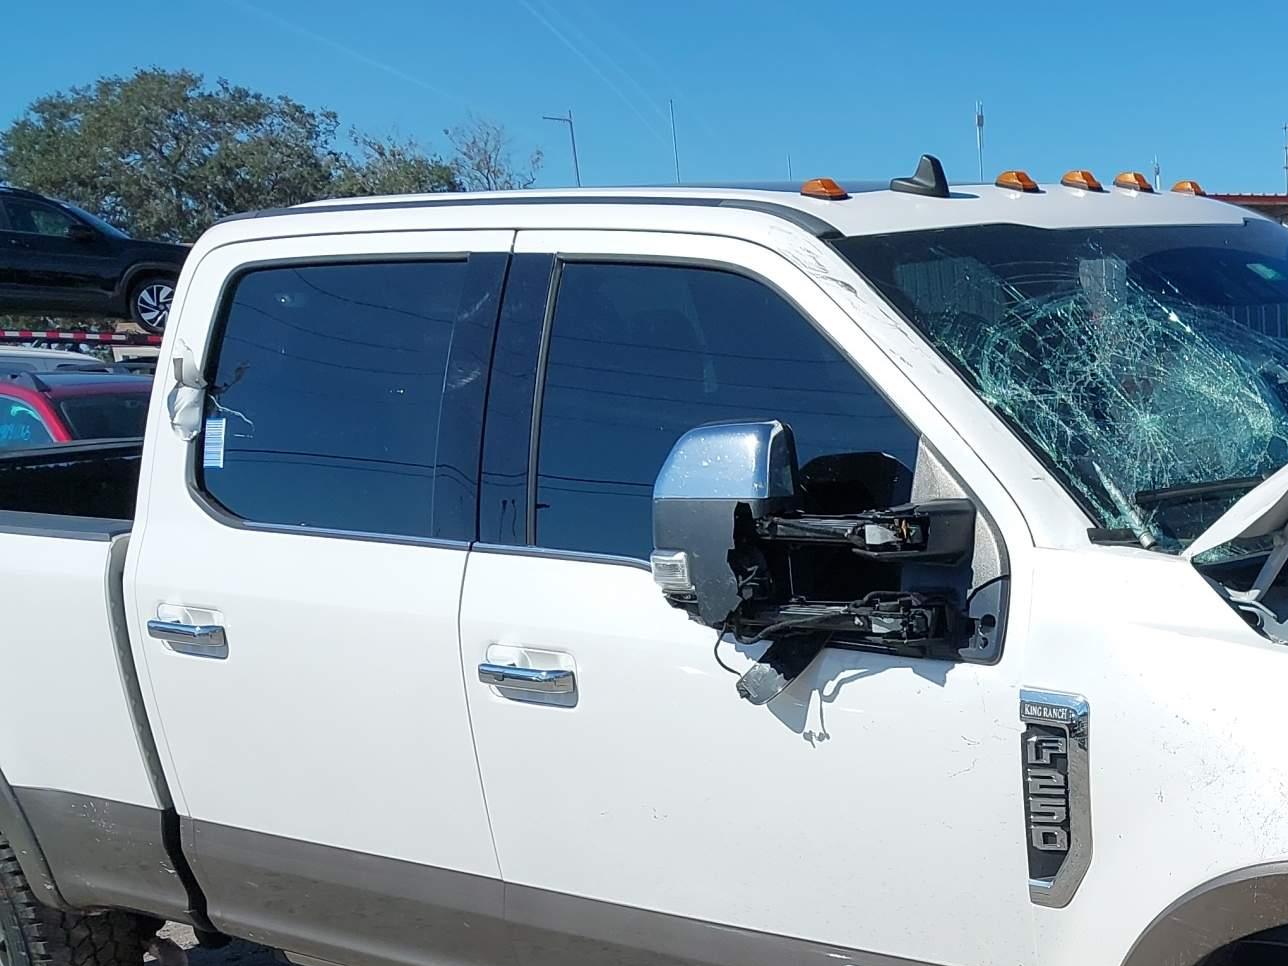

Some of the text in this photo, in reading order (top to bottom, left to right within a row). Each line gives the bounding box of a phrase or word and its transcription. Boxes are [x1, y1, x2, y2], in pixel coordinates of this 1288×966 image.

[1024, 703, 1067, 720] KING RANCH
[1027, 735, 1068, 851] F250
